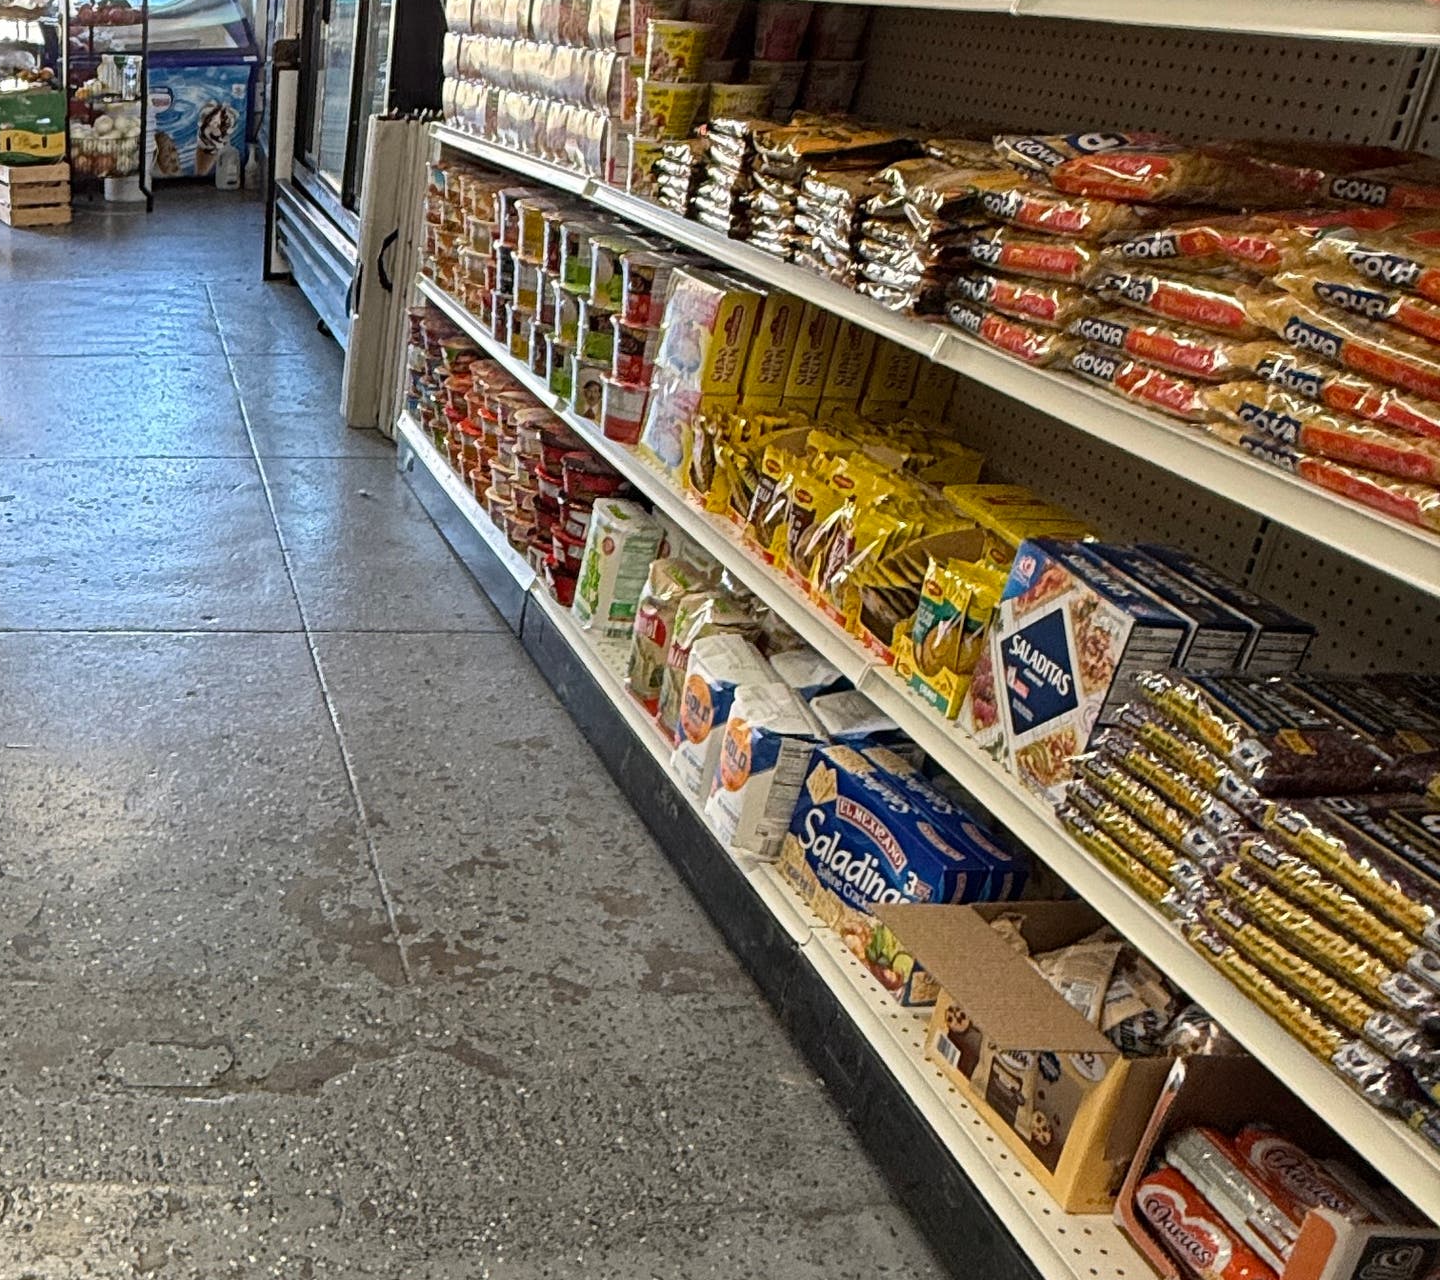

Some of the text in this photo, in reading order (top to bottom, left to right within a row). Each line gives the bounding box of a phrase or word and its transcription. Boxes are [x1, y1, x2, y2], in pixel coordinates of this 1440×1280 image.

[1332, 177, 1387, 205] GOYA
[1122, 236, 1177, 259] GOA
[1349, 251, 1421, 283] GOYA
[1080, 320, 1124, 347] GOYA
[1008, 634, 1073, 697] SALADITAS
[840, 801, 906, 870] EL MEXICANO
[904, 871, 917, 896] 3
